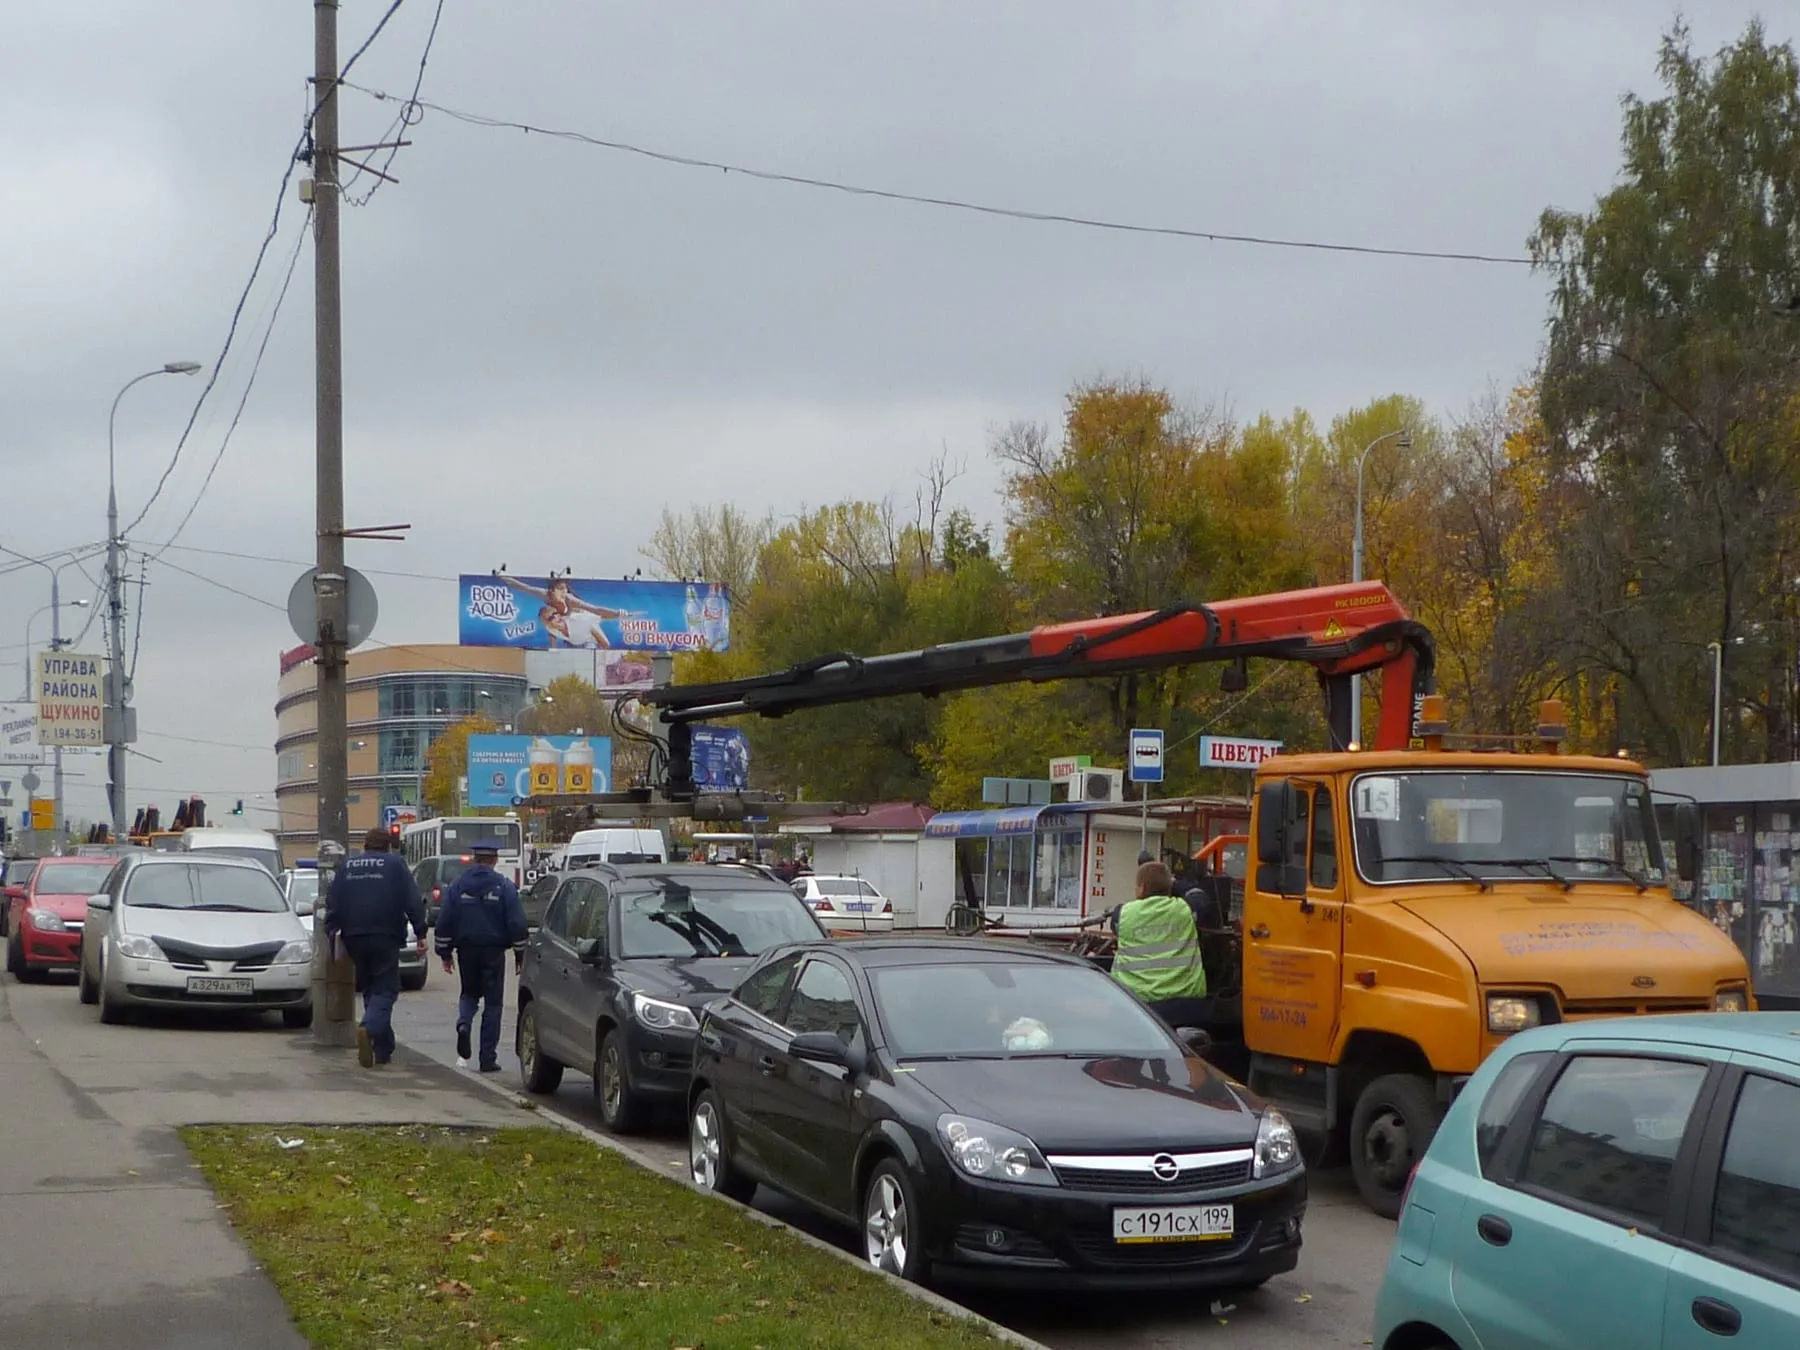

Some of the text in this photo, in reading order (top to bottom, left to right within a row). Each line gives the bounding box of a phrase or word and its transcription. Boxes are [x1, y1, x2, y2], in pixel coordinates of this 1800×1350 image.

[472, 587, 512, 601] BON-
[505, 622, 535, 638] Viva
[44, 659, 97, 676] УПРАВА
[43, 679, 98, 699] РАЙОНА
[41, 704, 101, 723] ЩУКИНО
[1360, 788, 1390, 813] 15
[1121, 1207, 1229, 1234] С191СХ 199
